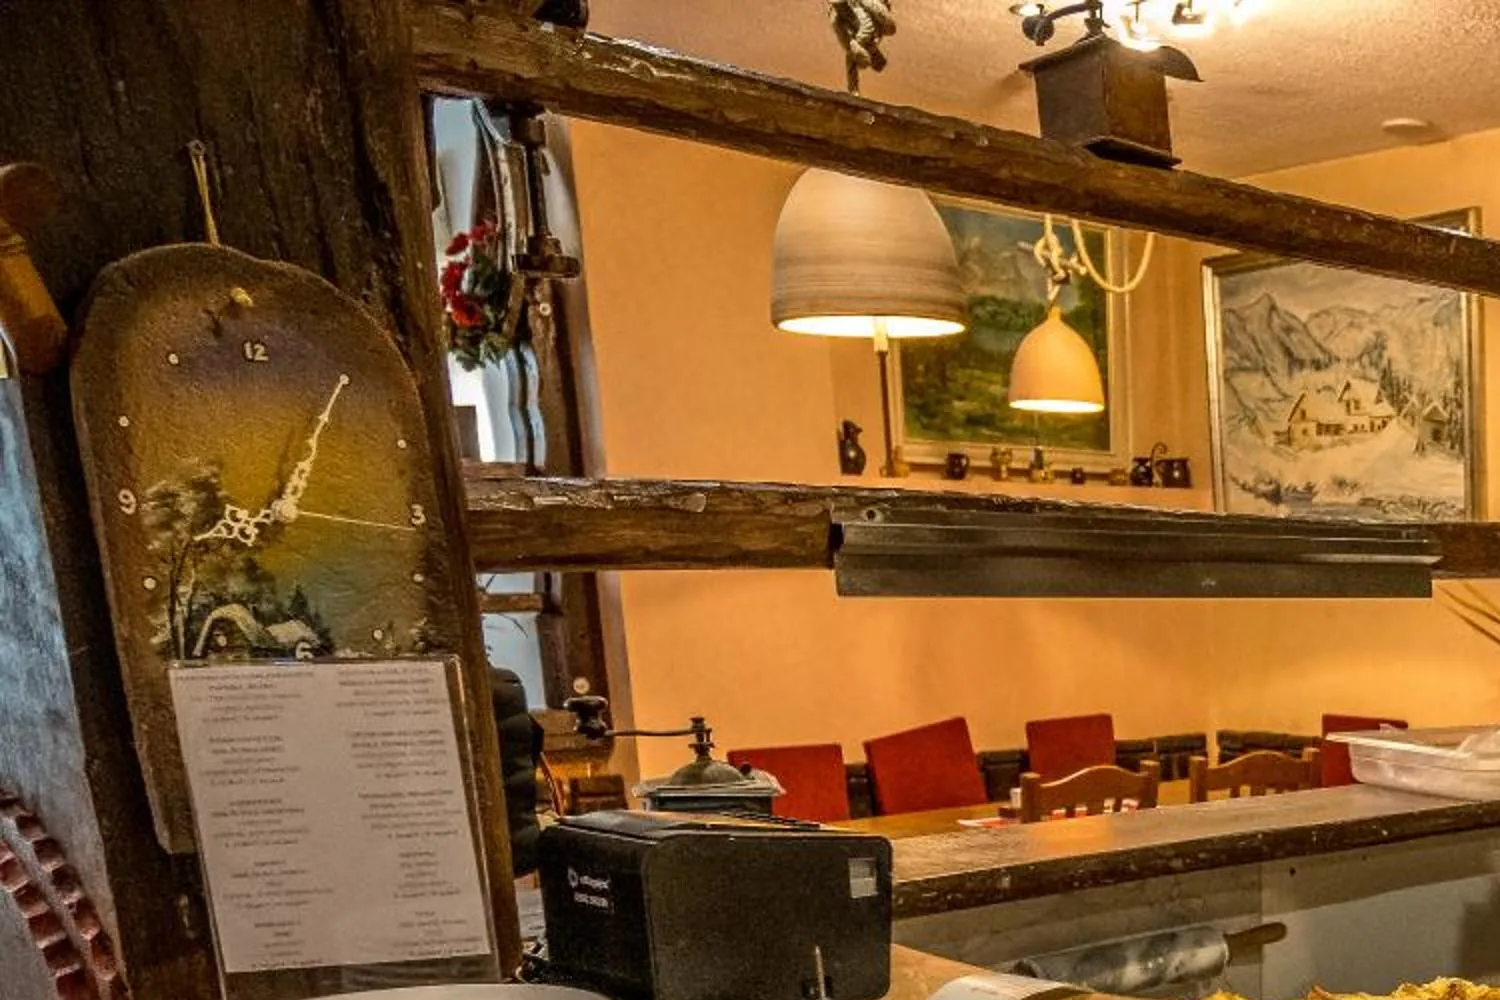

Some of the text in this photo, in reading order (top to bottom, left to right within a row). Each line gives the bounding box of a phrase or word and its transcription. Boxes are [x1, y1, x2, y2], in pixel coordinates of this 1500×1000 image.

[244, 341, 269, 360] 12
[119, 489, 137, 514] 9
[411, 504, 426, 525] 3
[296, 642, 314, 660] 6
